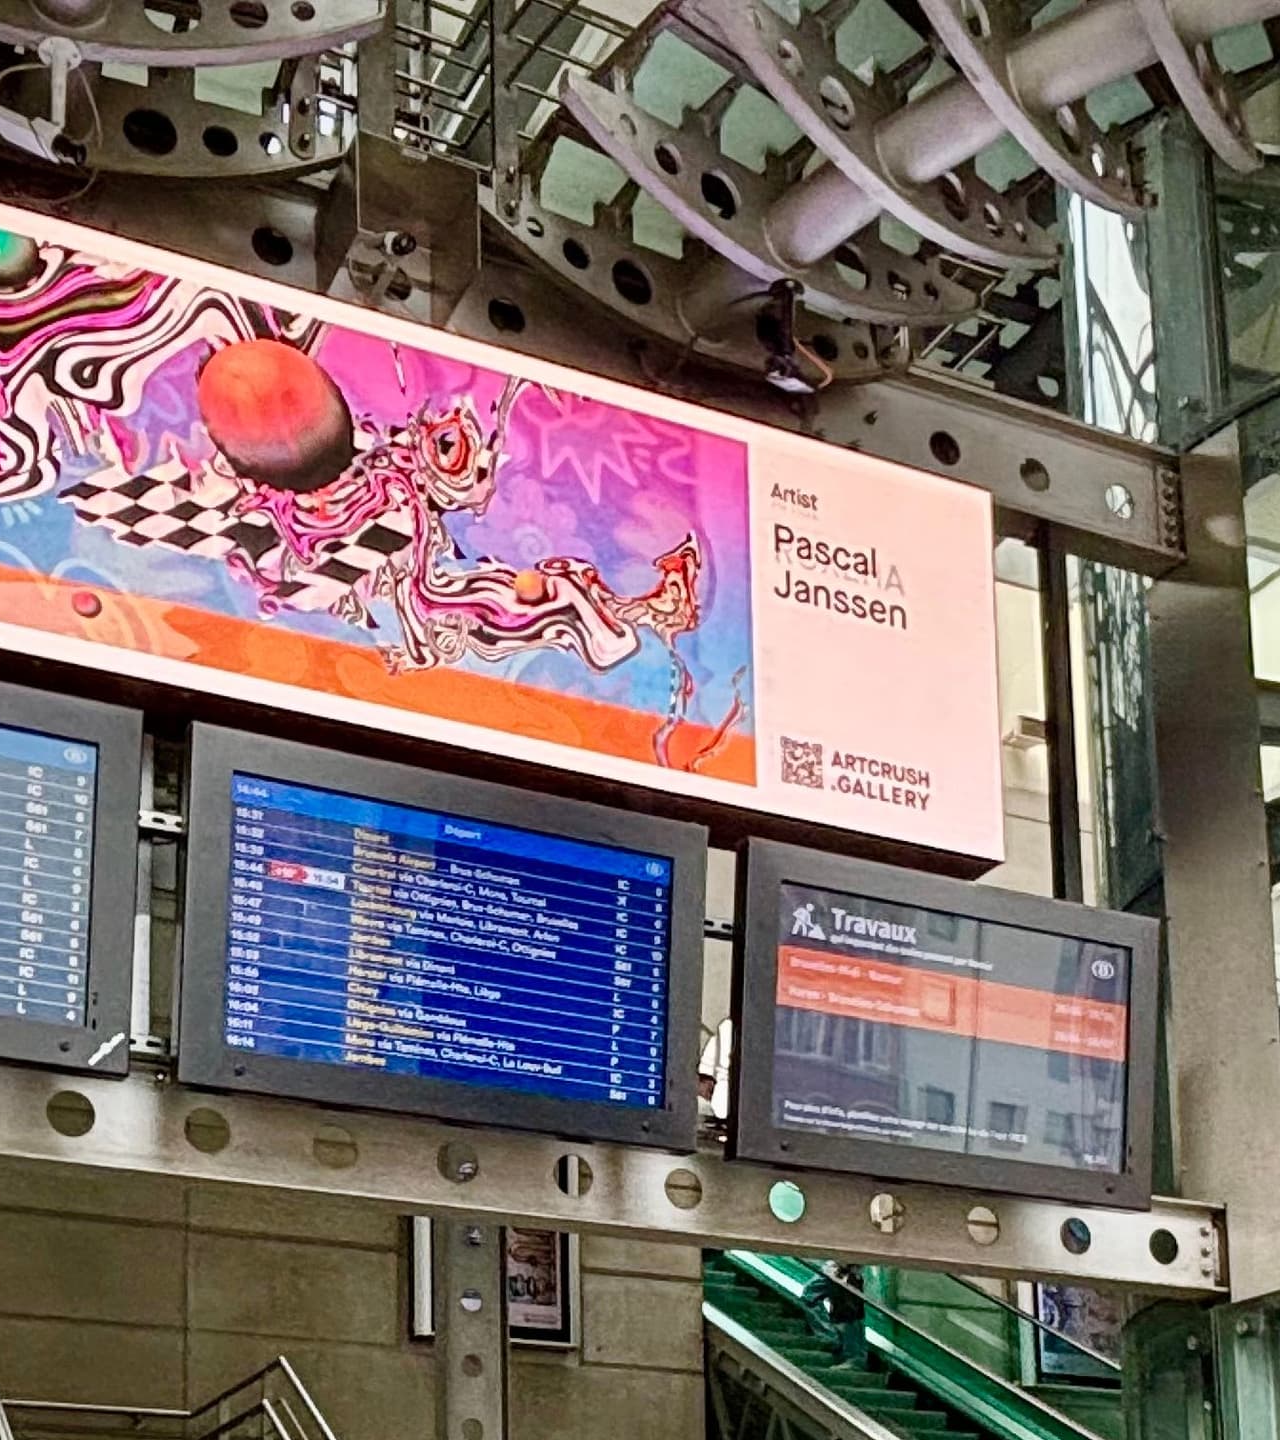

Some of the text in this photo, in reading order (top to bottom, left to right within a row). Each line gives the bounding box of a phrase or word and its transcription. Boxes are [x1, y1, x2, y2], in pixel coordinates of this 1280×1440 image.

[771, 483, 818, 511] Artist
[774, 523, 877, 578] Pascal
[774, 570, 907, 630] Janssen
[27, 765, 43, 778] IC
[831, 750, 930, 789] ARTCRUSH
[26, 783, 42, 797] IC
[830, 774, 930, 811] .GALLERY
[22, 856, 39, 869] IC
[21, 892, 37, 905] IC
[392, 887, 409, 899] via
[419, 908, 434, 920] via
[831, 907, 917, 944] Travaux
[18, 946, 35, 960] IC
[17, 965, 34, 978] IC
[388, 971, 404, 984] via
[377, 1038, 392, 1050] via
